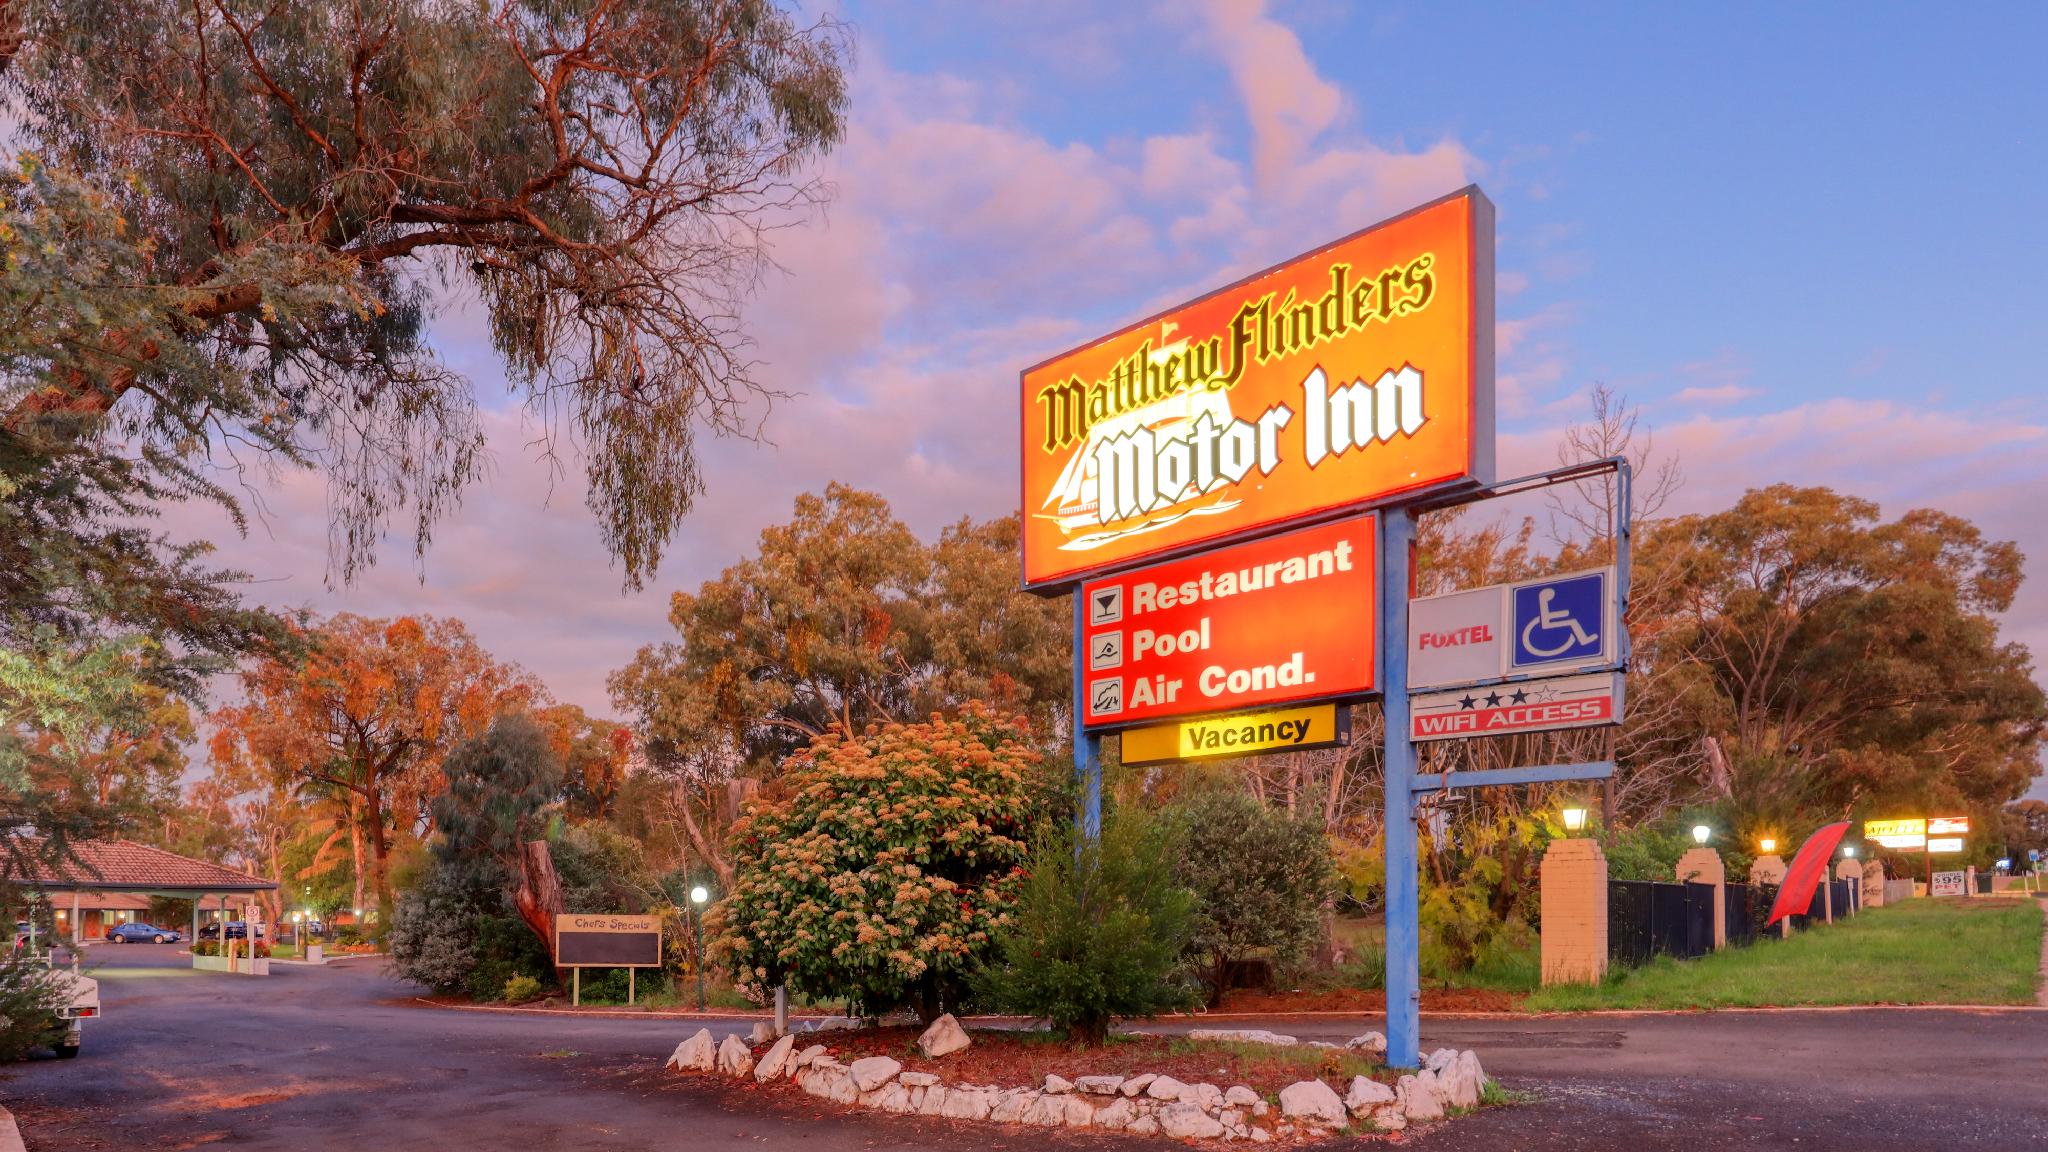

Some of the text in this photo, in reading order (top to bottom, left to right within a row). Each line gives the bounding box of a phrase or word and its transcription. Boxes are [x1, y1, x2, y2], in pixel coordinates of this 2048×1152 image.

[1037, 253, 1436, 454] Matthew Flinders
[1091, 361, 1430, 527] Motor Inn
[1132, 540, 1353, 616] Restaurant
[1132, 617, 1211, 661] Pool
[1419, 625, 1493, 650] FOXTEL
[1129, 652, 1316, 709] Air Cond.
[1188, 717, 1311, 750] Vacancy
[1419, 700, 1601, 733] WIFI ACCESS
[574, 918, 650, 931] Chefs Specials
